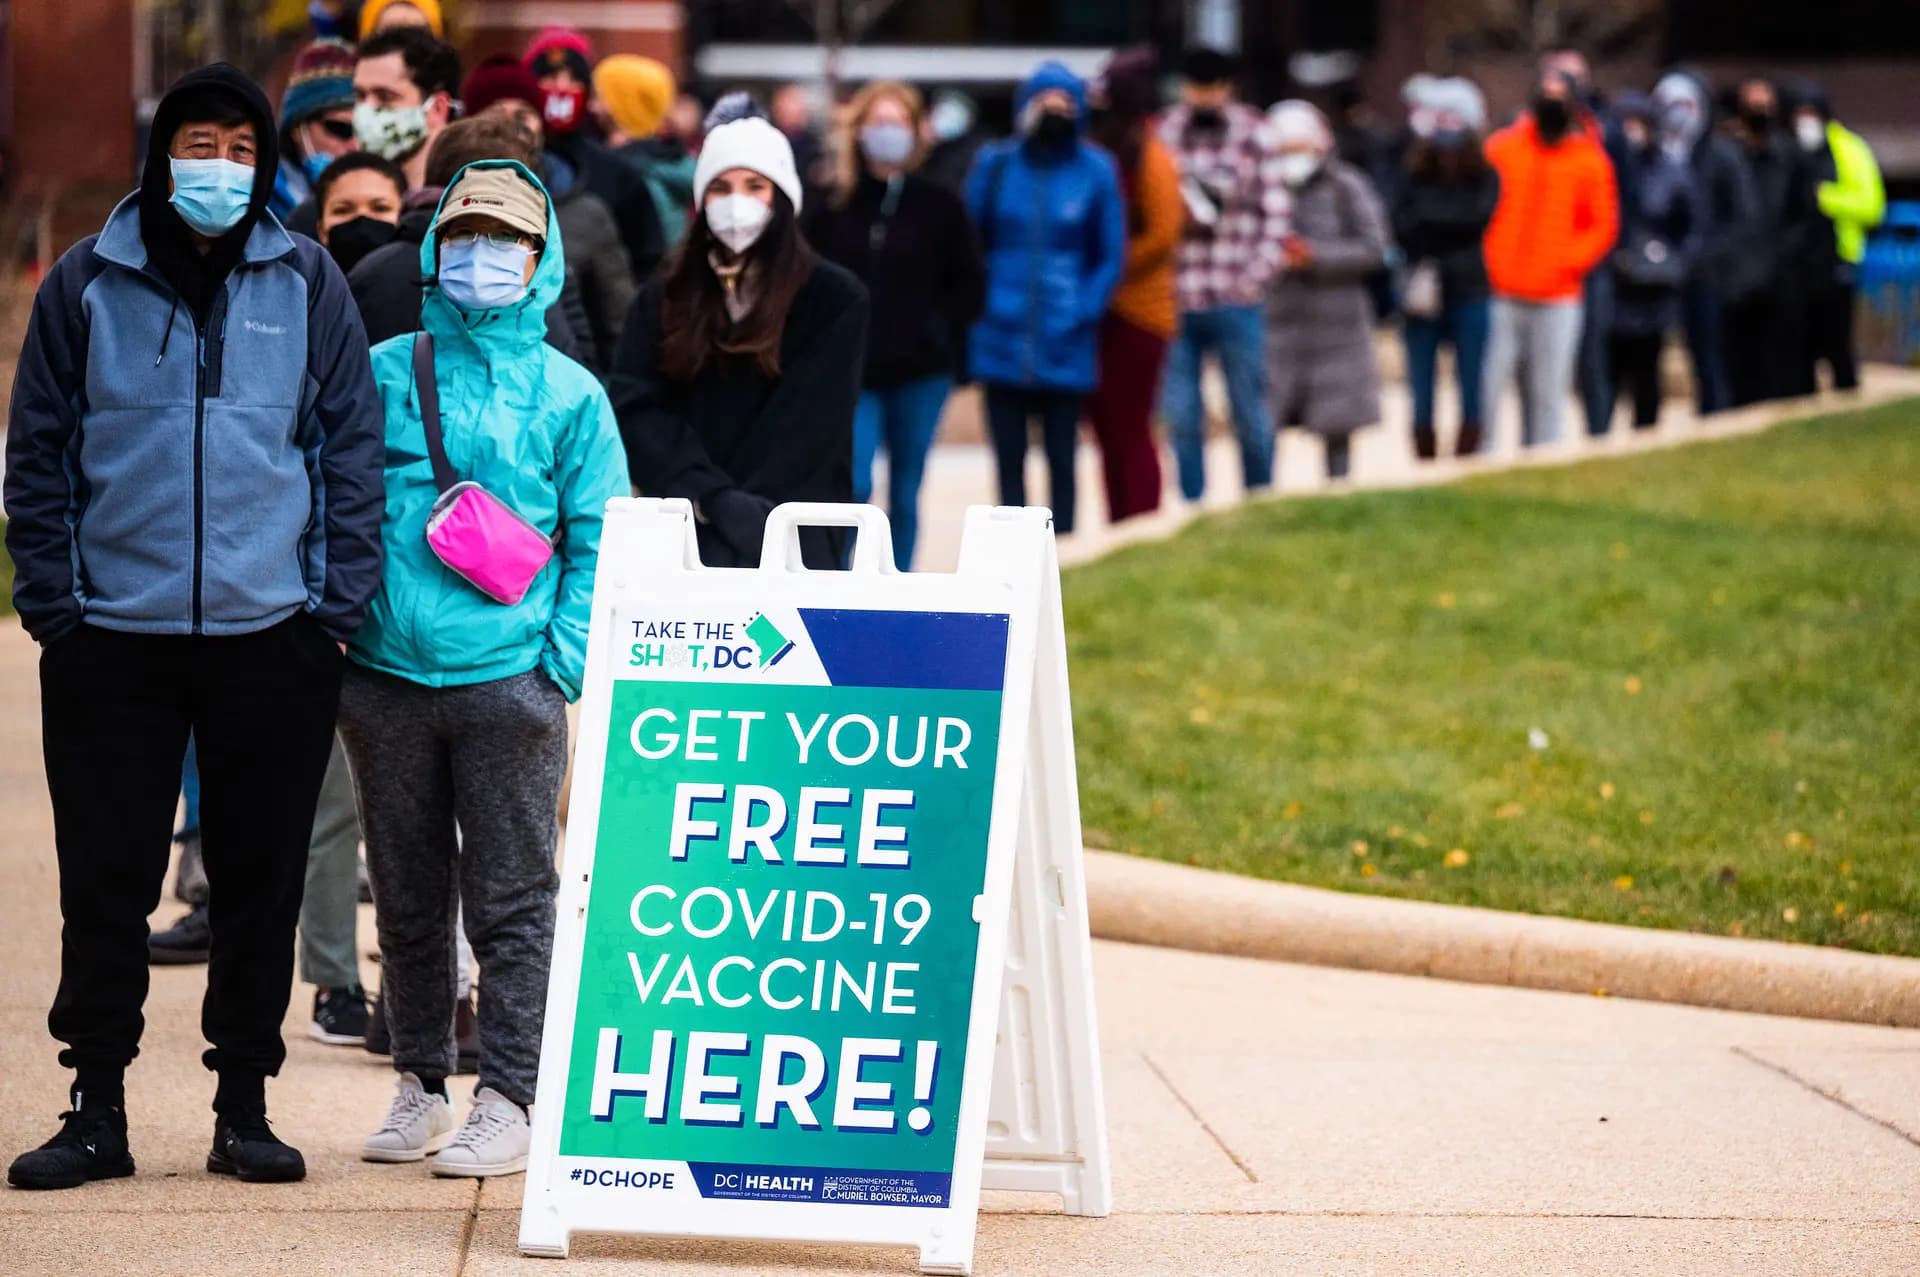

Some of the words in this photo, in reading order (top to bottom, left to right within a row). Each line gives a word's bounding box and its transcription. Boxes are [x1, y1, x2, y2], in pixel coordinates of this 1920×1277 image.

[632, 620, 687, 640] TAKE
[693, 622, 735, 641] THE
[713, 645, 753, 669] DC
[630, 708, 765, 762] GET
[786, 712, 971, 769] YOUR
[669, 782, 916, 867] FREE
[630, 885, 931, 945] COVID-19
[627, 952, 919, 1014] VACCINE
[590, 1028, 939, 1132] HERE!
[570, 1168, 675, 1190] #DCHOPE
[714, 1173, 739, 1189] DC
[745, 1175, 814, 1192] HEALTH
[838, 1176, 888, 1185] GOVERNMENT
[901, 1179, 915, 1187] THE
[838, 1184, 869, 1192] DISTRICT
[869, 1185, 880, 1193] OF
[881, 1186, 918, 1194] COLUMBIA
[836, 1191, 869, 1201] MURIEL
[870, 1192, 909, 1204] BOWSER,
[910, 1194, 942, 1204] MAYOR
